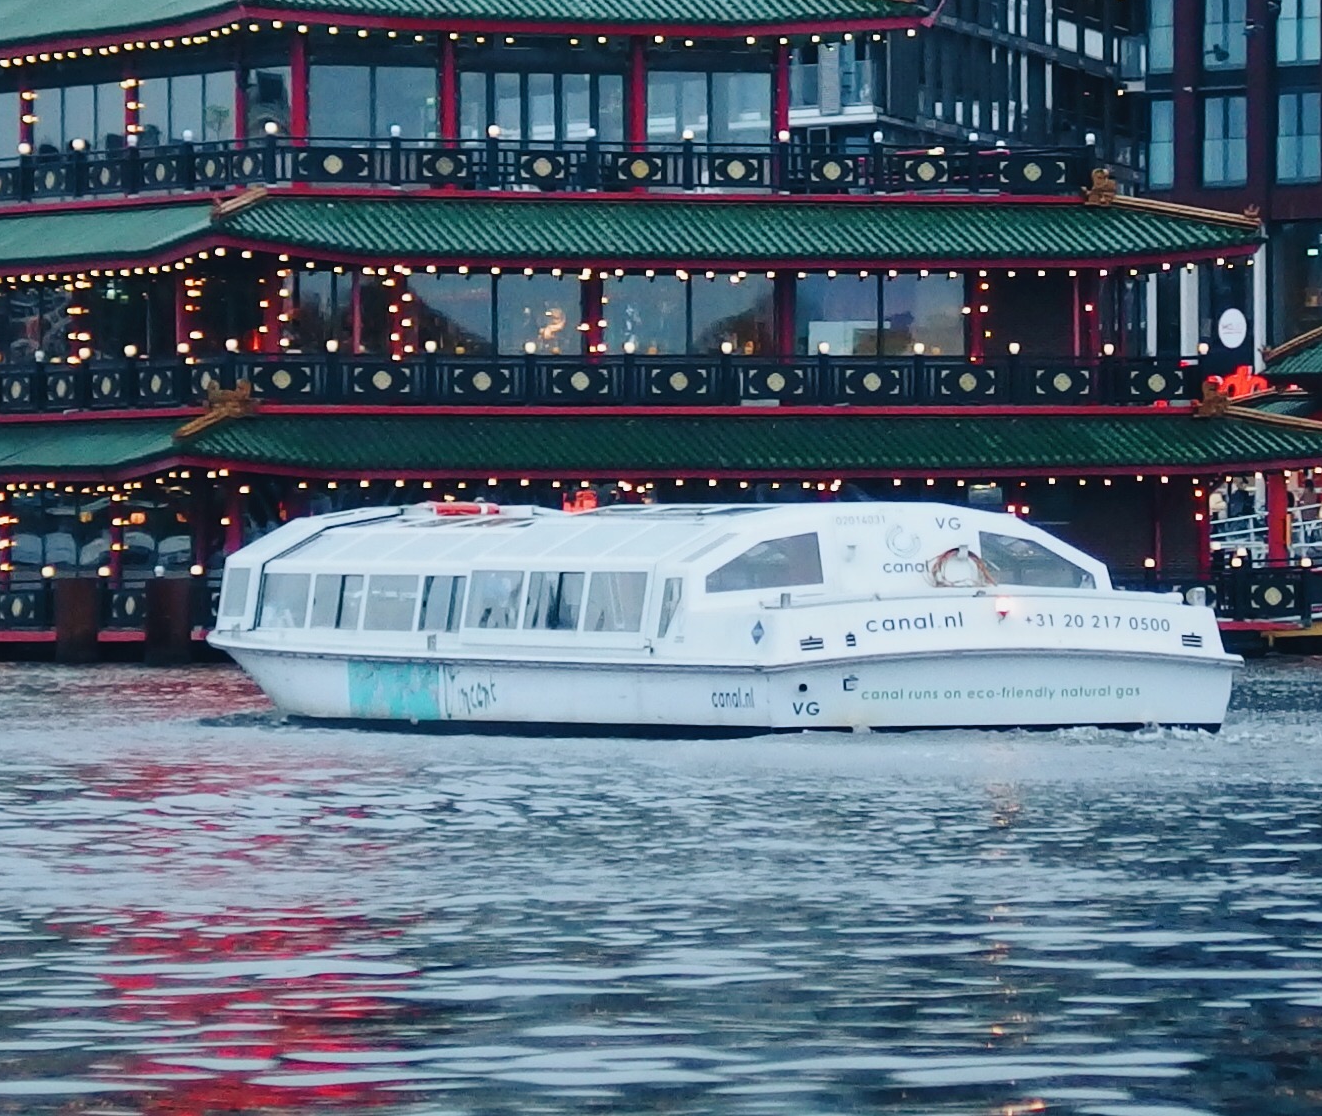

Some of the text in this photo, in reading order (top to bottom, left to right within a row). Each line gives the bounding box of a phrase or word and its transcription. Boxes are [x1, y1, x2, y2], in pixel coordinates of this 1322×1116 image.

[935, 516, 962, 531] VG
[882, 559, 930, 574] canal
[865, 610, 965, 633] canal.nl
[1025, 613, 1171, 632] +31 20 217 0500
[711, 687, 756, 709] canal.nl
[860, 685, 1141, 701] canal runs on eco-friendly natural gas
[792, 701, 821, 716] VG
